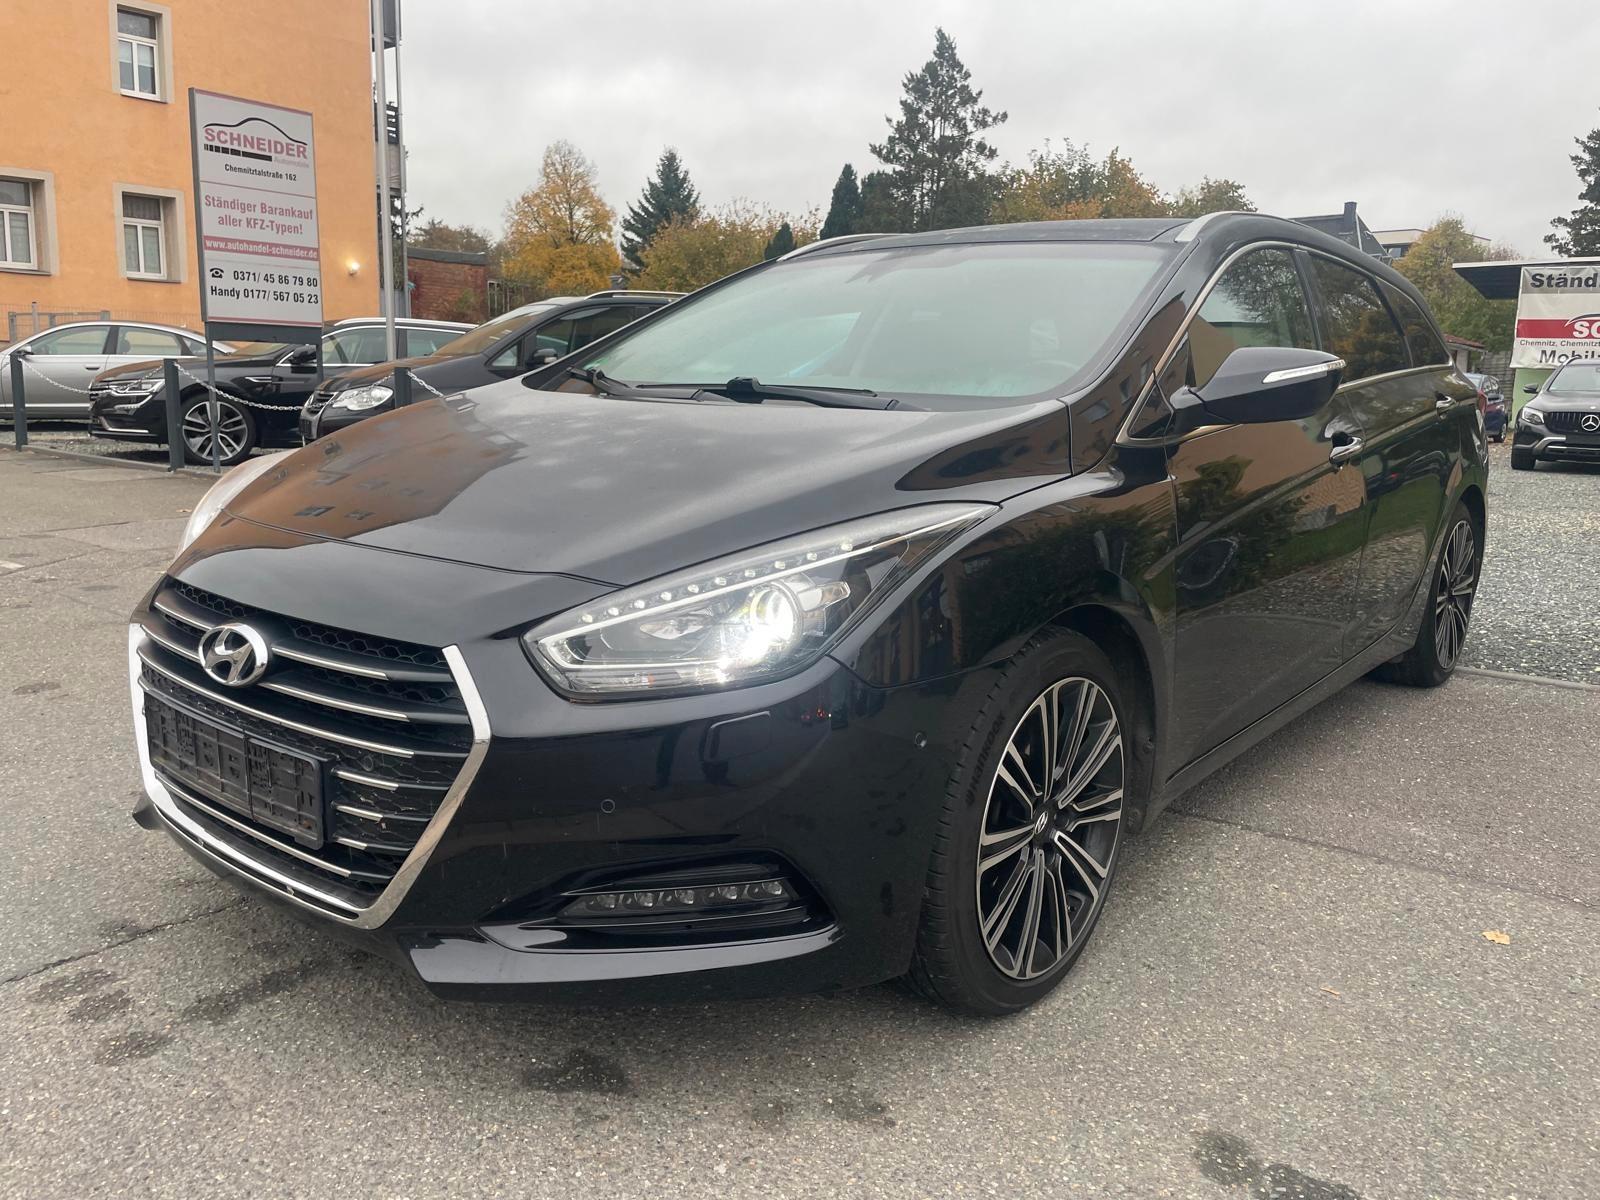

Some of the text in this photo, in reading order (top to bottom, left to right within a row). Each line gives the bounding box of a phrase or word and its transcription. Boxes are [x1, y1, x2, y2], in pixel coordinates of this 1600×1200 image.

[204, 127, 308, 159] SCHNEIDER
[224, 163, 297, 181] Chemnitztalstraße 162
[204, 194, 313, 220] Ständiger Barankauf
[218, 214, 303, 235] aller KFZ-Typen!
[205, 239, 318, 259] www.autohandel-schneider.de
[233, 270, 318, 288] 0371/ 45 86 79 80
[1531, 273, 1600, 288] Ständ
[210, 285, 319, 304] Handy 0177/ 567 05 23
[1519, 339, 1558, 347] Chemnitz,
